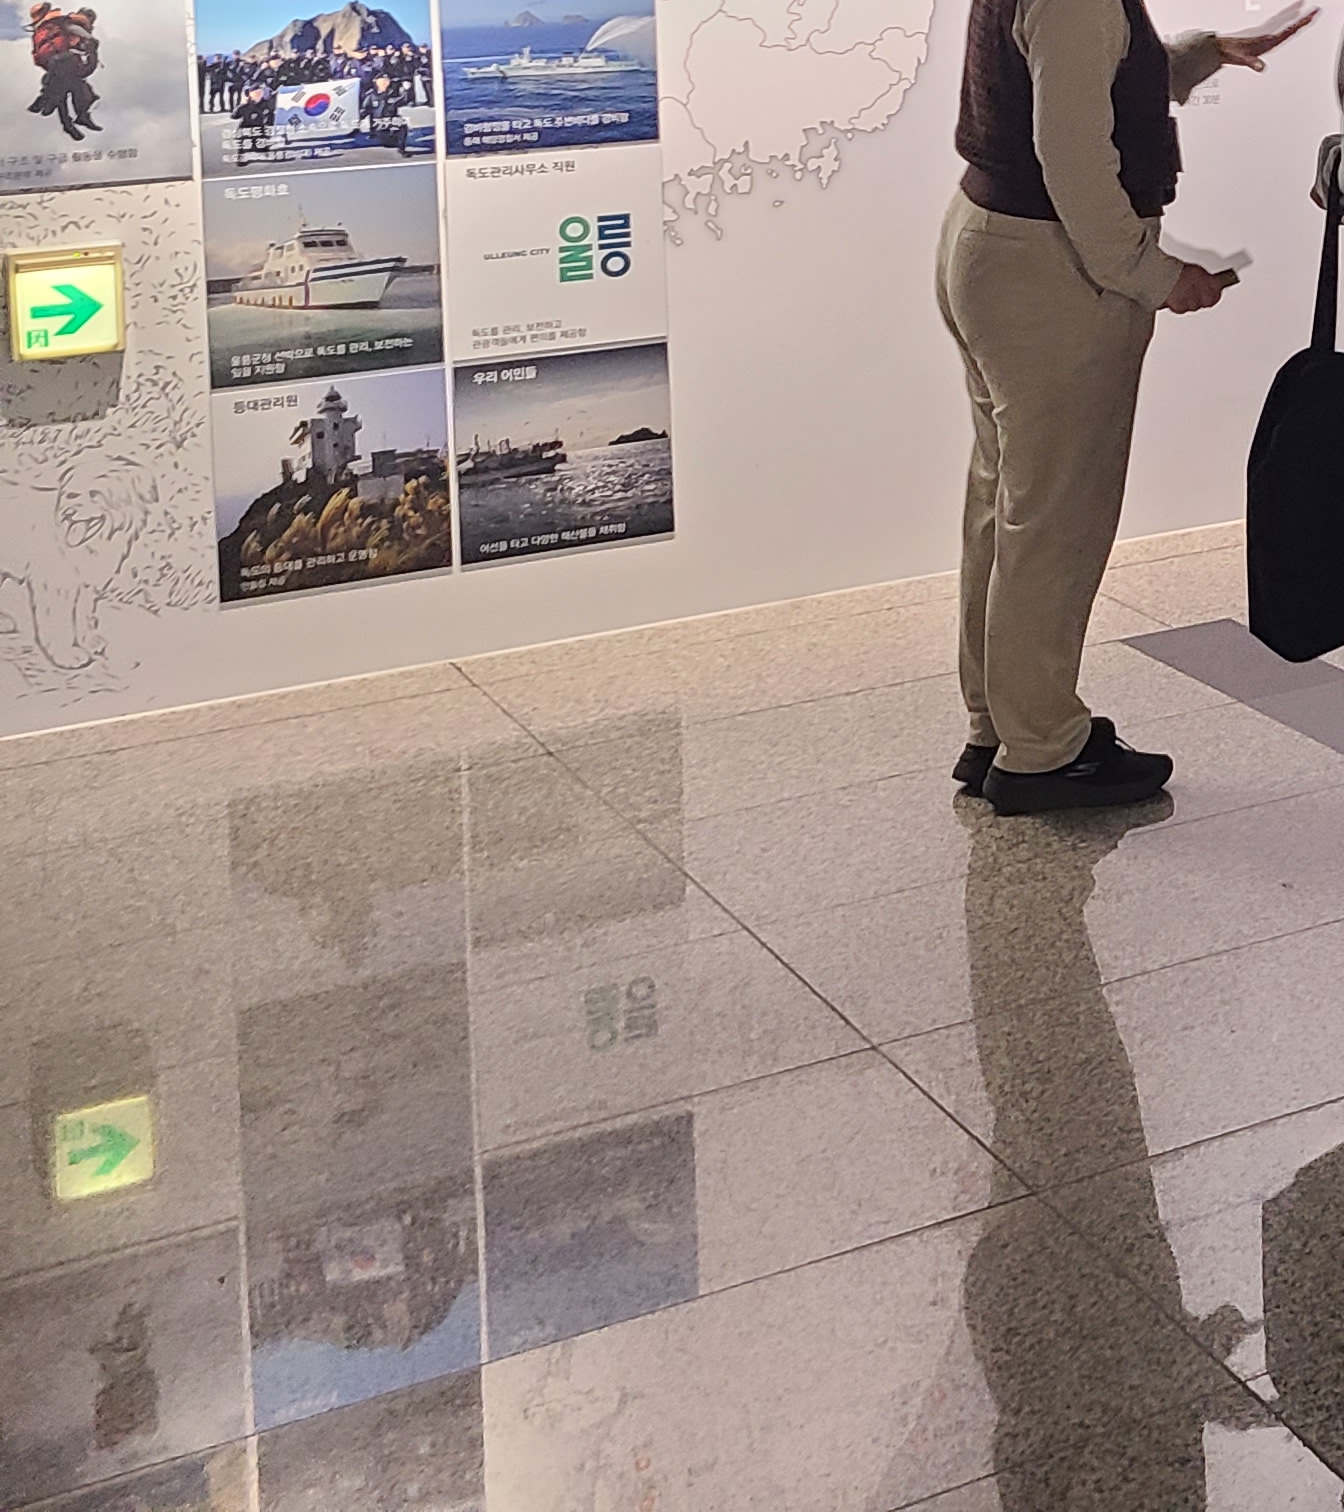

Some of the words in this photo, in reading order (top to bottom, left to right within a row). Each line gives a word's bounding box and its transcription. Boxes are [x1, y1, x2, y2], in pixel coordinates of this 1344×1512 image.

[466, 162, 549, 180] 독도관리사무소
[552, 160, 576, 173] 직원
[223, 184, 289, 201] 독도평화호
[483, 249, 528, 260] ULLEUNG
[529, 247, 551, 256] CITY
[316, 344, 347, 356] 독도를
[472, 370, 498, 385] 우리
[500, 366, 538, 382] 어민들
[233, 395, 299, 414] 등대관리원
